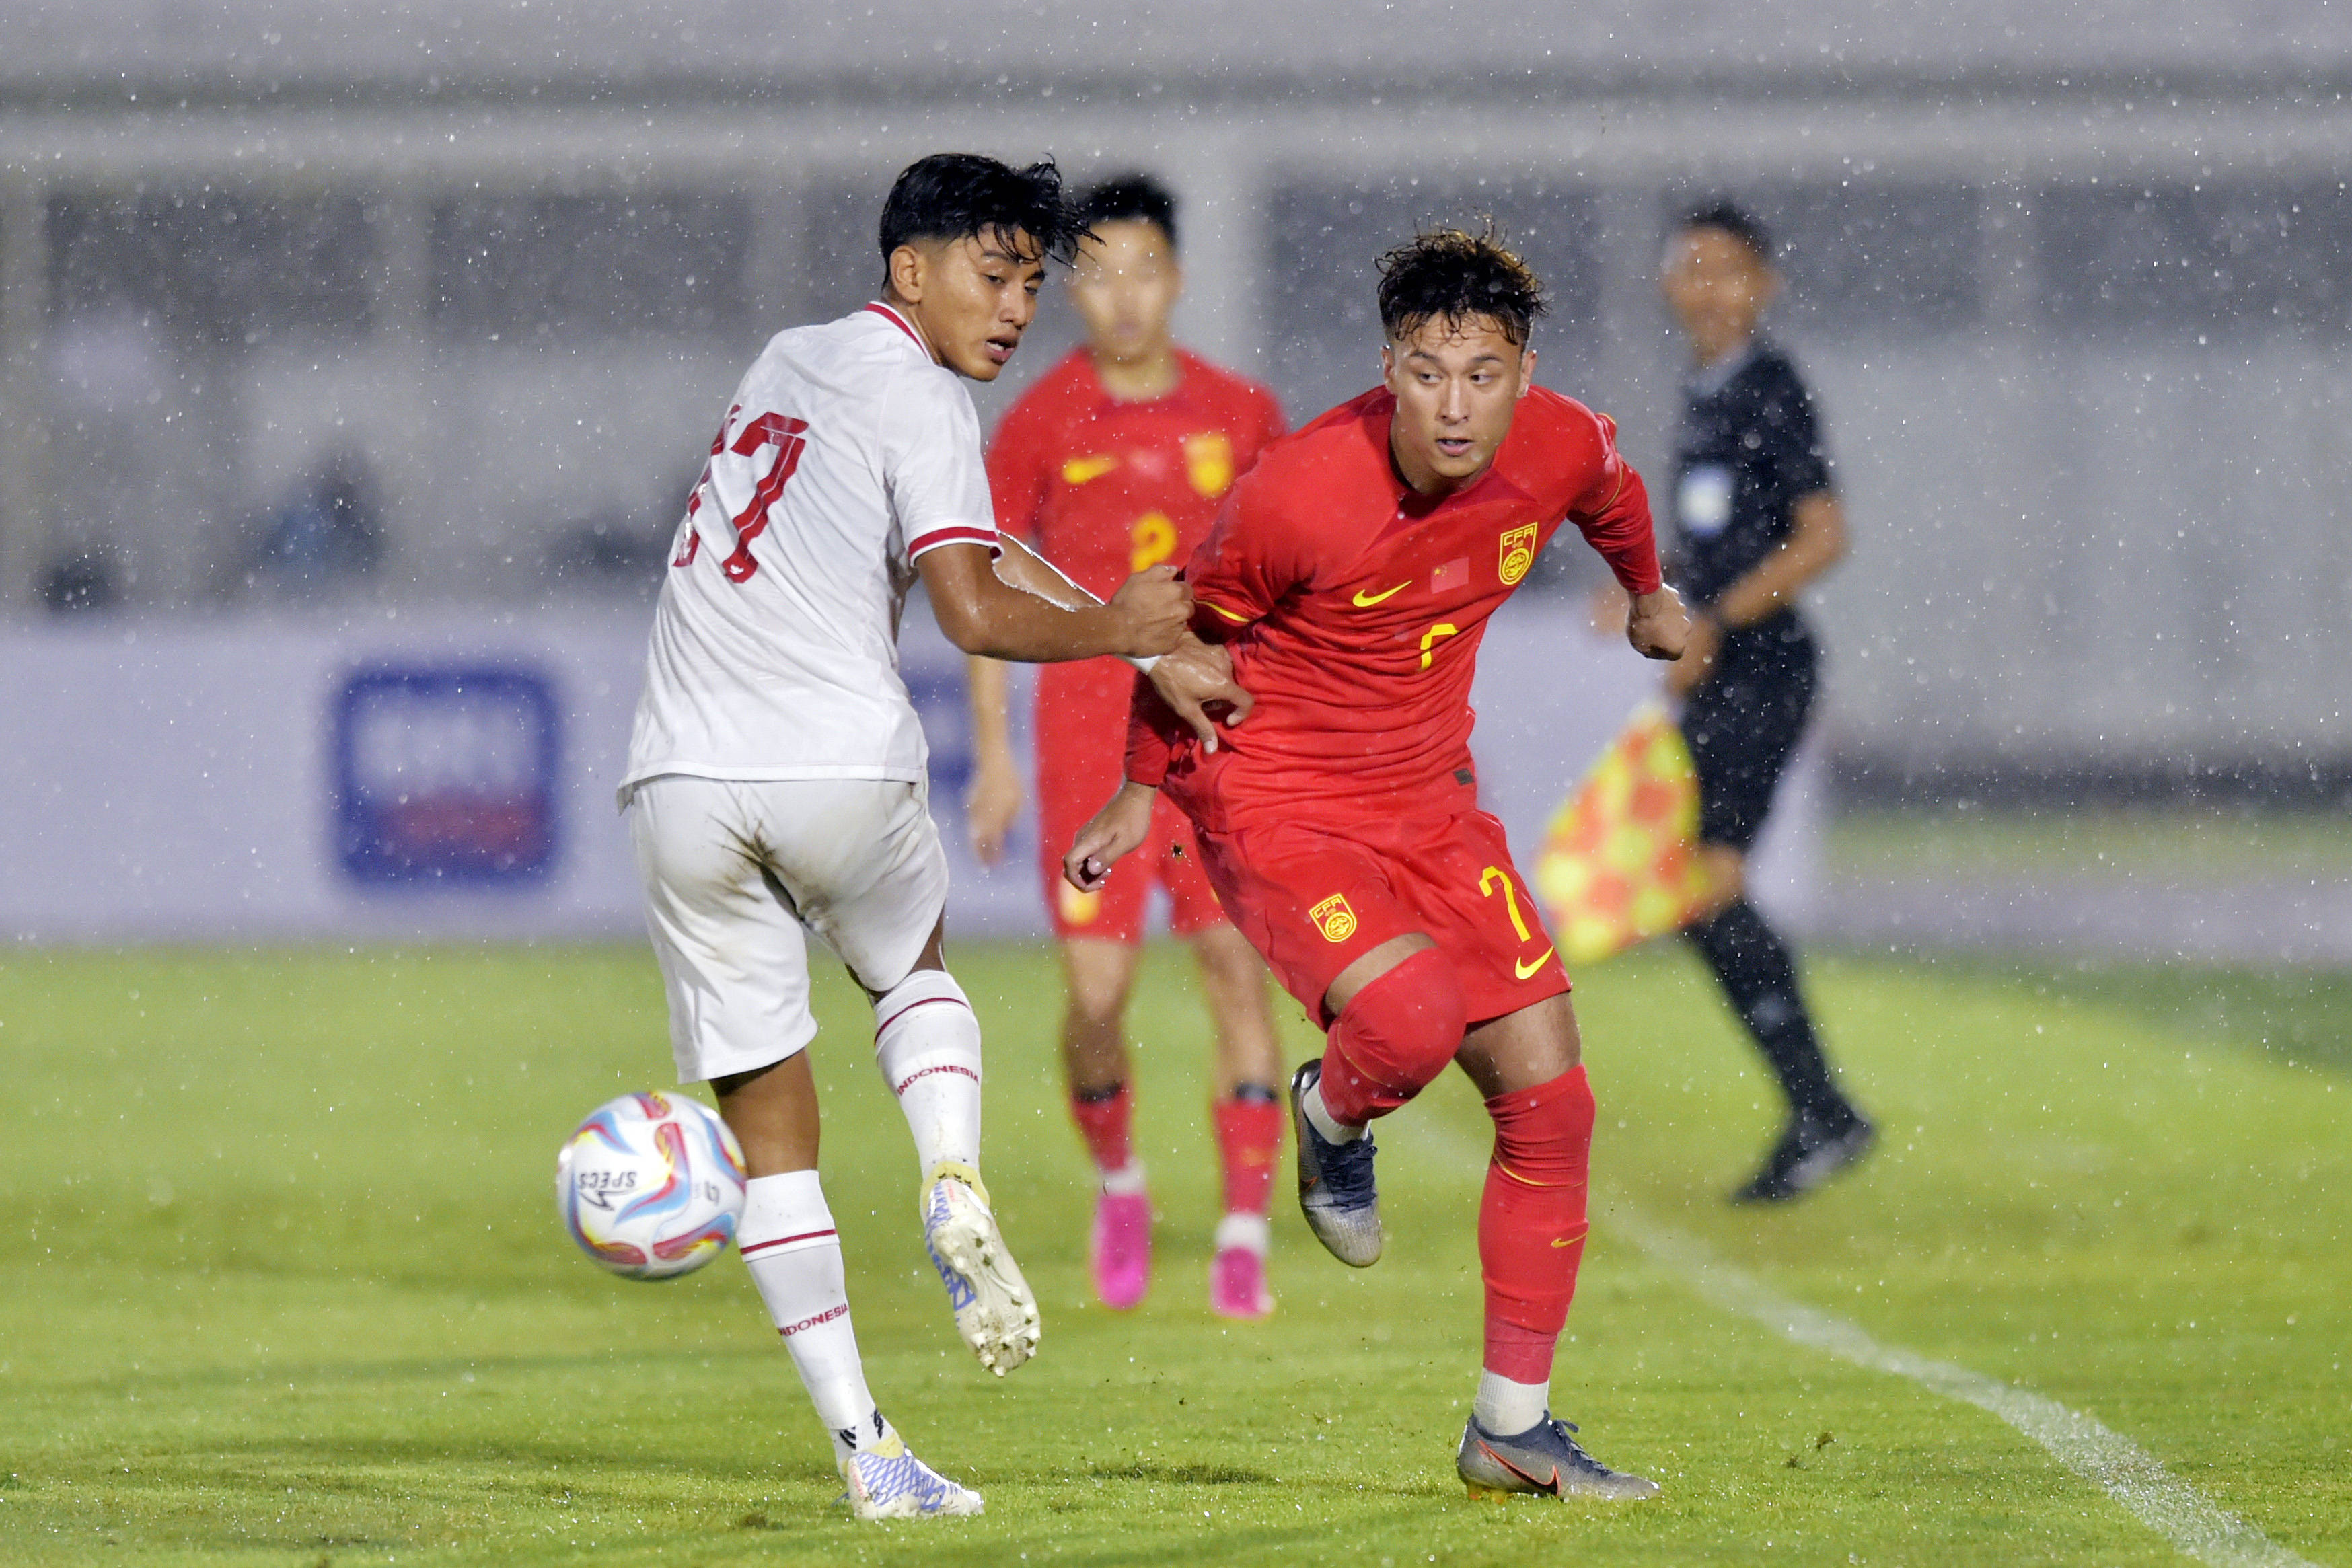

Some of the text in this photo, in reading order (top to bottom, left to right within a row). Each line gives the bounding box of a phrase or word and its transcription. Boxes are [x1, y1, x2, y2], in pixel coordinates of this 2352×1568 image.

[1504, 527, 1534, 547] CFA
[1313, 897, 1342, 919] CFA
[1479, 866, 1531, 942] 7
[579, 1171, 638, 1190] SPECS
